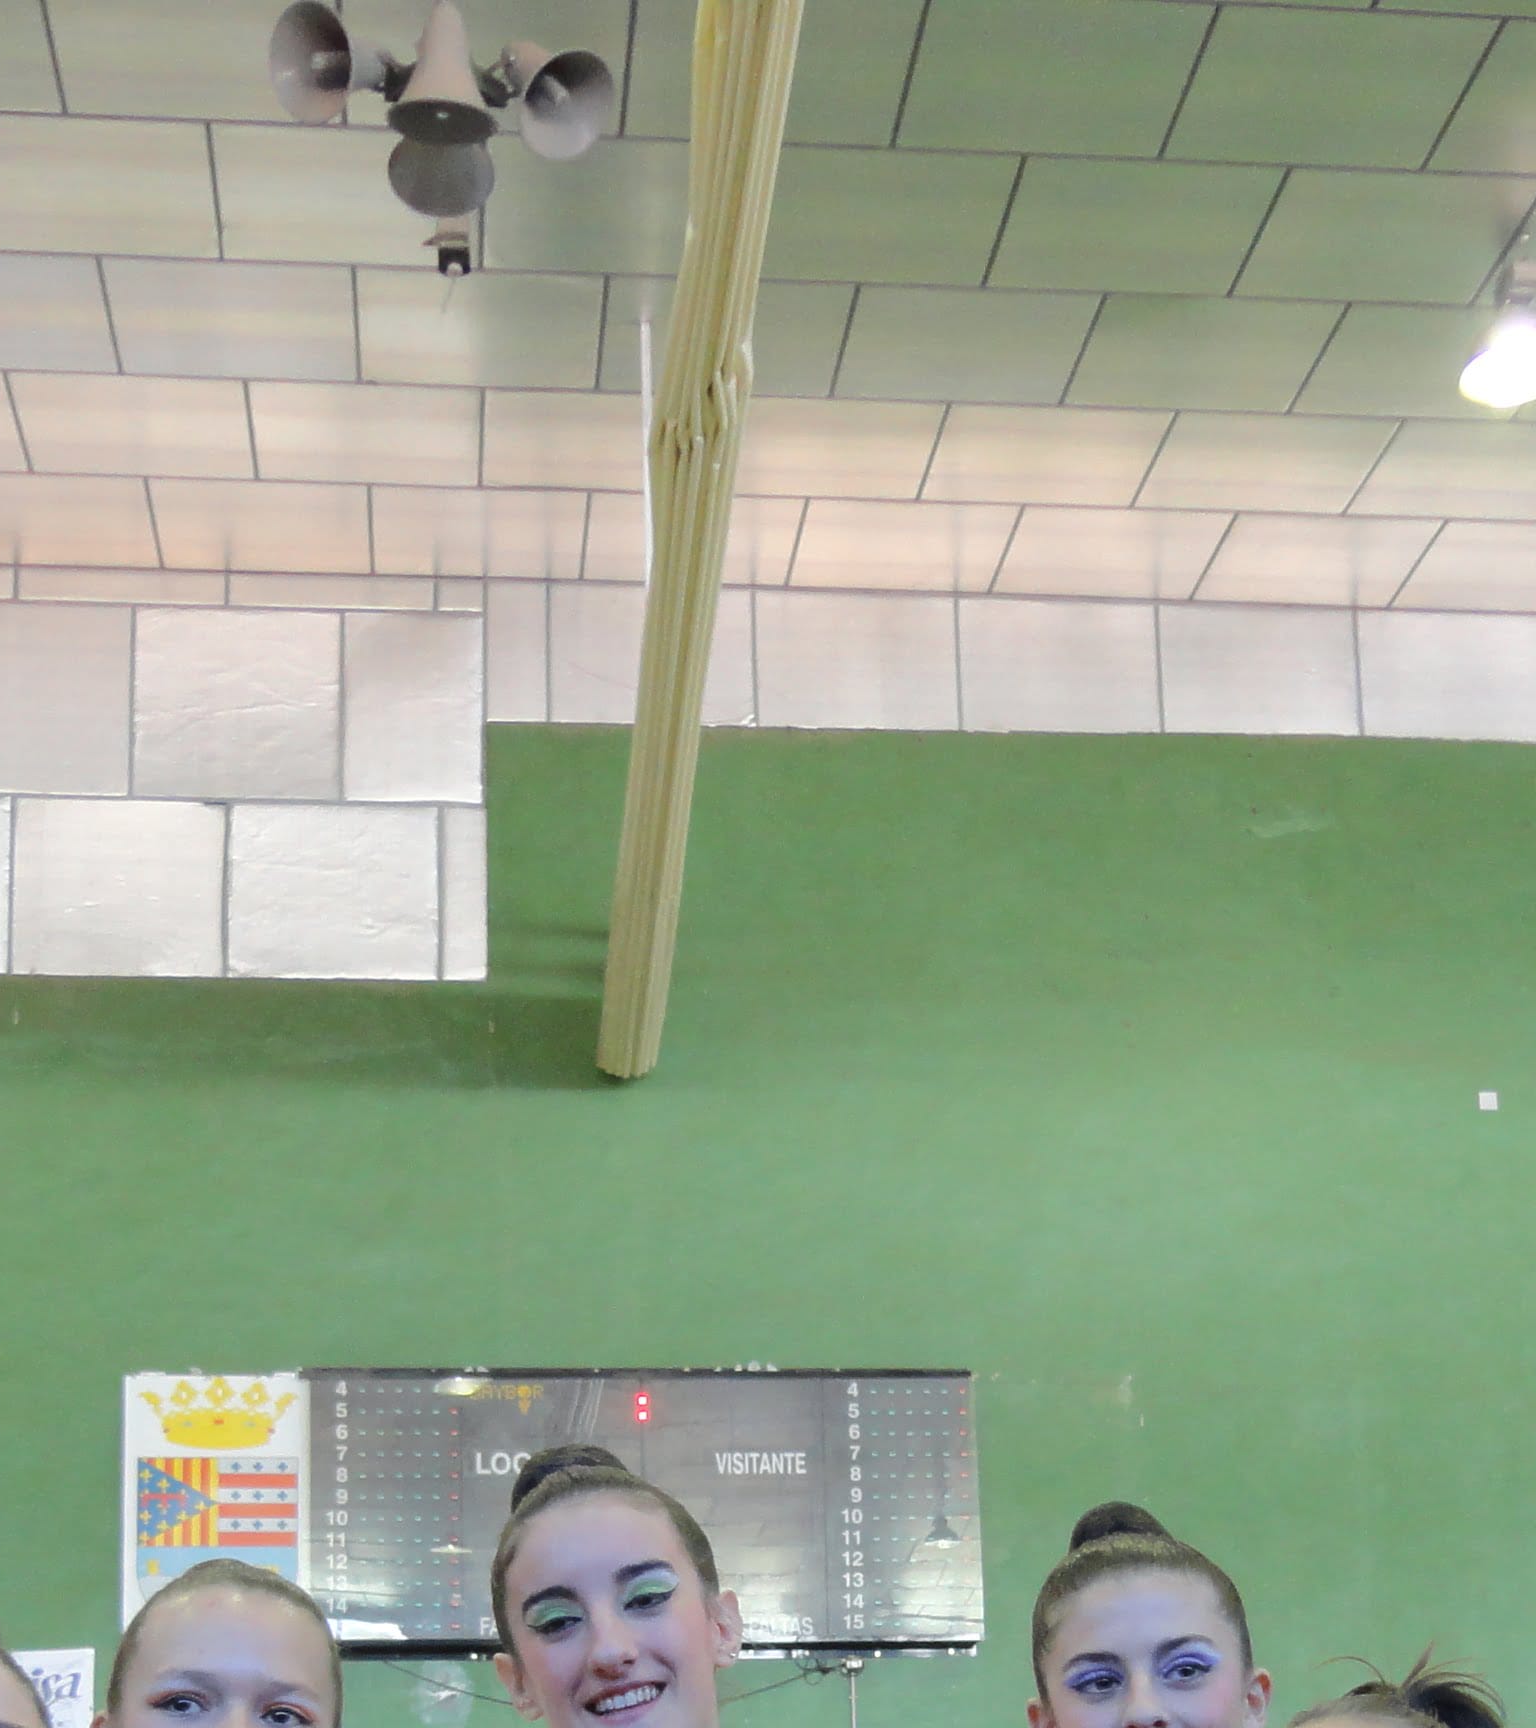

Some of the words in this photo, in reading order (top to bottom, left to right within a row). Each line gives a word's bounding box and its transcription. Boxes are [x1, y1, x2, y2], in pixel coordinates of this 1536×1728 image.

[336, 1381, 348, 1396] 4
[847, 1382, 859, 1397] 4
[336, 1403, 348, 1418] 5
[848, 1403, 860, 1418] 5
[336, 1425, 348, 1439] 6
[848, 1424, 860, 1439] 6
[336, 1446, 348, 1461] 7
[849, 1446, 861, 1460] 7
[475, 1452, 532, 1475] LOC
[715, 1452, 808, 1475] VISITANTE
[336, 1468, 348, 1483] 8
[850, 1467, 862, 1481] 8
[336, 1489, 348, 1504] 9
[851, 1488, 862, 1503] 9
[326, 1511, 348, 1526] 10
[841, 1508, 863, 1523] 10
[326, 1533, 346, 1548] 11
[842, 1530, 861, 1544] 11
[326, 1554, 348, 1569] 12
[843, 1552, 864, 1566] 12
[843, 1573, 864, 1587] 13
[326, 1598, 348, 1613] 14
[844, 1594, 865, 1608] 14
[844, 1615, 865, 1630] 15
